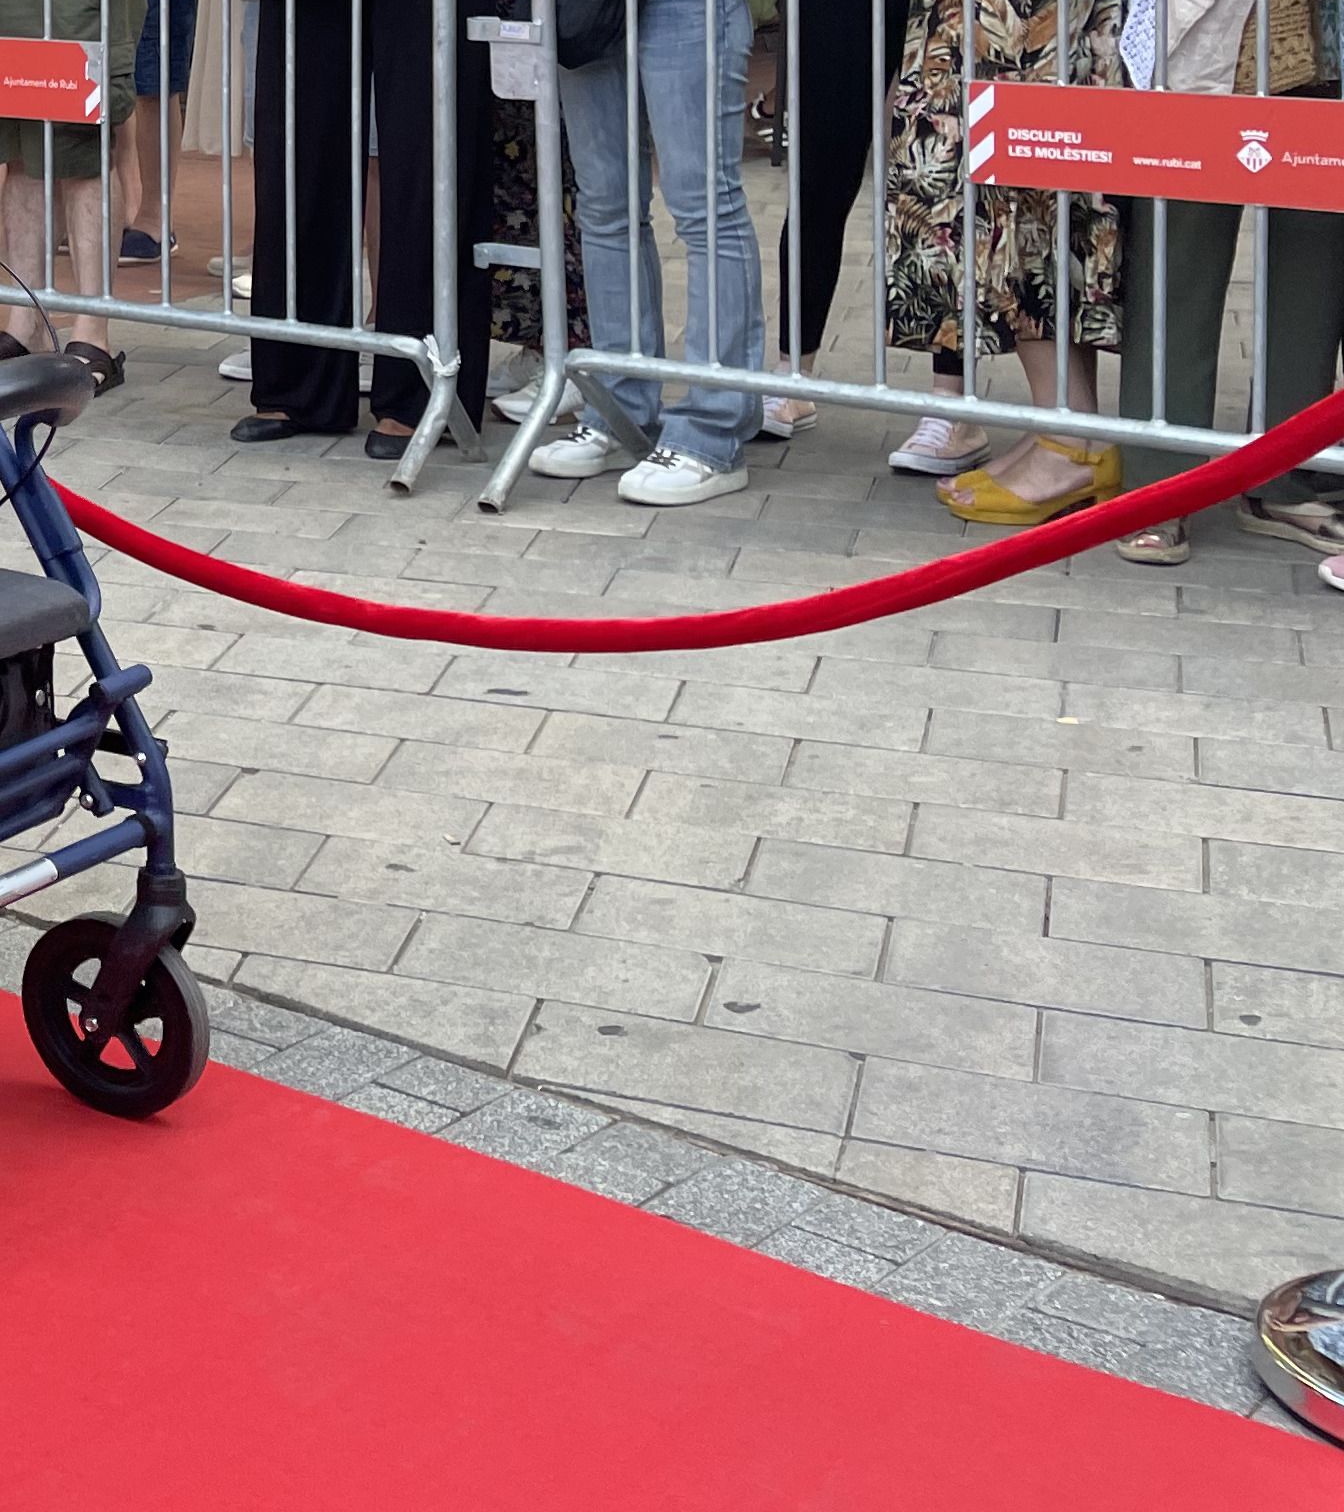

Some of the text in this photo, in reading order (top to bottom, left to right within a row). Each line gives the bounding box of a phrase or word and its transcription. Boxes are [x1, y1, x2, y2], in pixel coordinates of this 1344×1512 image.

[3, 76, 48, 88] Ajuntament
[48, 78, 59, 89] de
[1007, 128, 1082, 144] DISCULPEU
[1007, 144, 1114, 164] LES MOLÈSTIES!
[1132, 156, 1202, 172] www.rubi.cat
